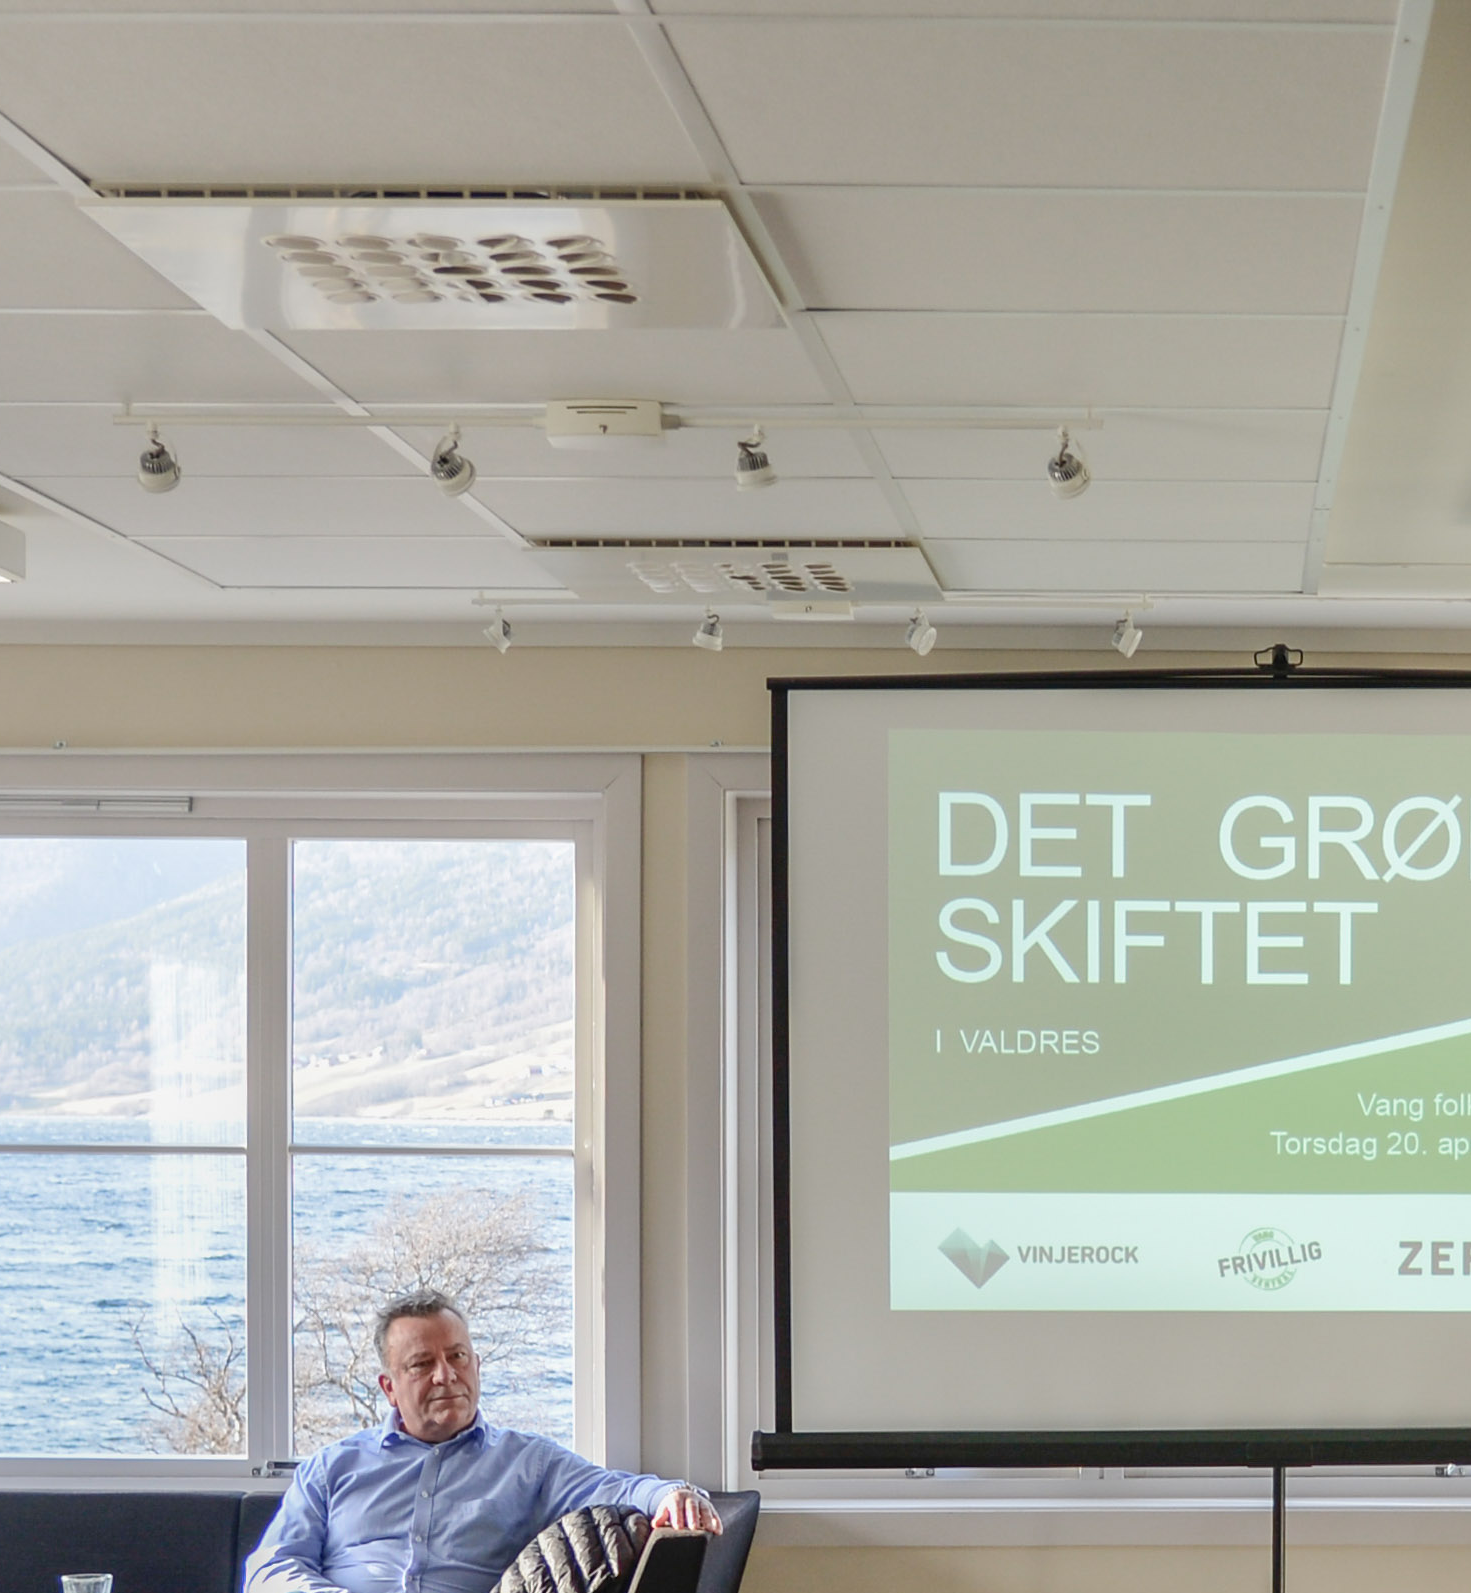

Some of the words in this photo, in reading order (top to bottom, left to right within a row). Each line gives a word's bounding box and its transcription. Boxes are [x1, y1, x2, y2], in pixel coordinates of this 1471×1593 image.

[938, 791, 1151, 878] DET
[935, 898, 1378, 985] SKIFTET
[935, 1030, 941, 1054] I
[959, 1030, 1101, 1055] VALDRES
[1357, 1093, 1425, 1123] Vang
[1270, 1131, 1379, 1162] Torsdag
[1386, 1131, 1429, 1155] 20.
[1016, 1244, 1140, 1266] VINJEROCK
[1217, 1240, 1323, 1278] FRIVILLIG
